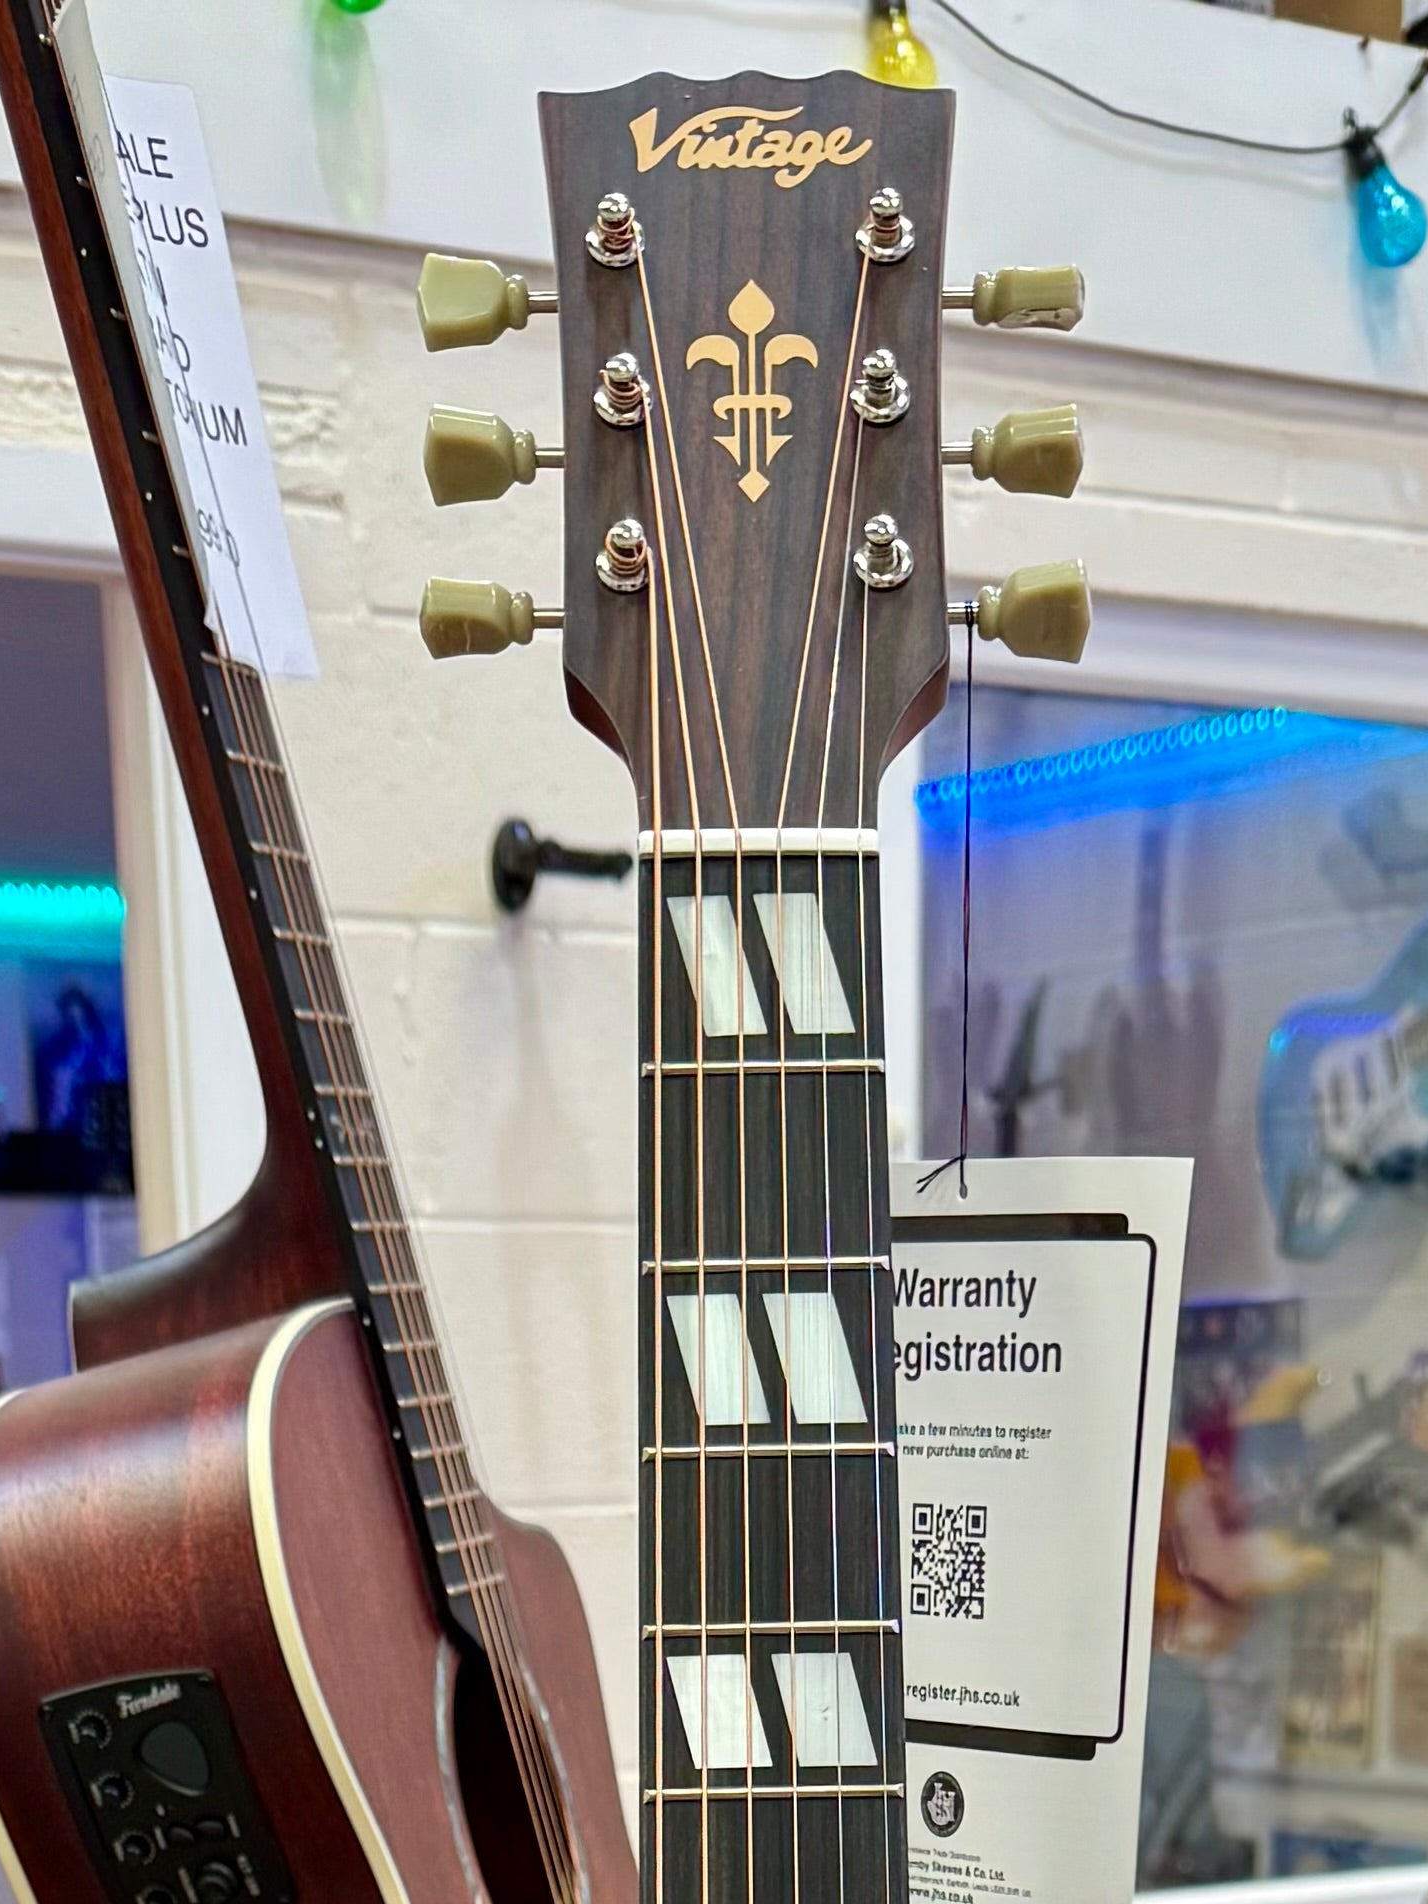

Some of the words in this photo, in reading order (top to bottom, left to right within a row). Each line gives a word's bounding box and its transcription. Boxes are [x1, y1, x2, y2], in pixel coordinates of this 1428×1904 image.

[629, 106, 872, 189] Vintage
[894, 1268, 1037, 1318] Warranty
[928, 1423, 946, 1436] few
[949, 1424, 992, 1437] minutes
[996, 1425, 1006, 1438] to
[1009, 1426, 1052, 1442] register
[903, 1445, 924, 1455] new
[927, 1444, 976, 1459] purchase
[979, 1445, 1012, 1459] online
